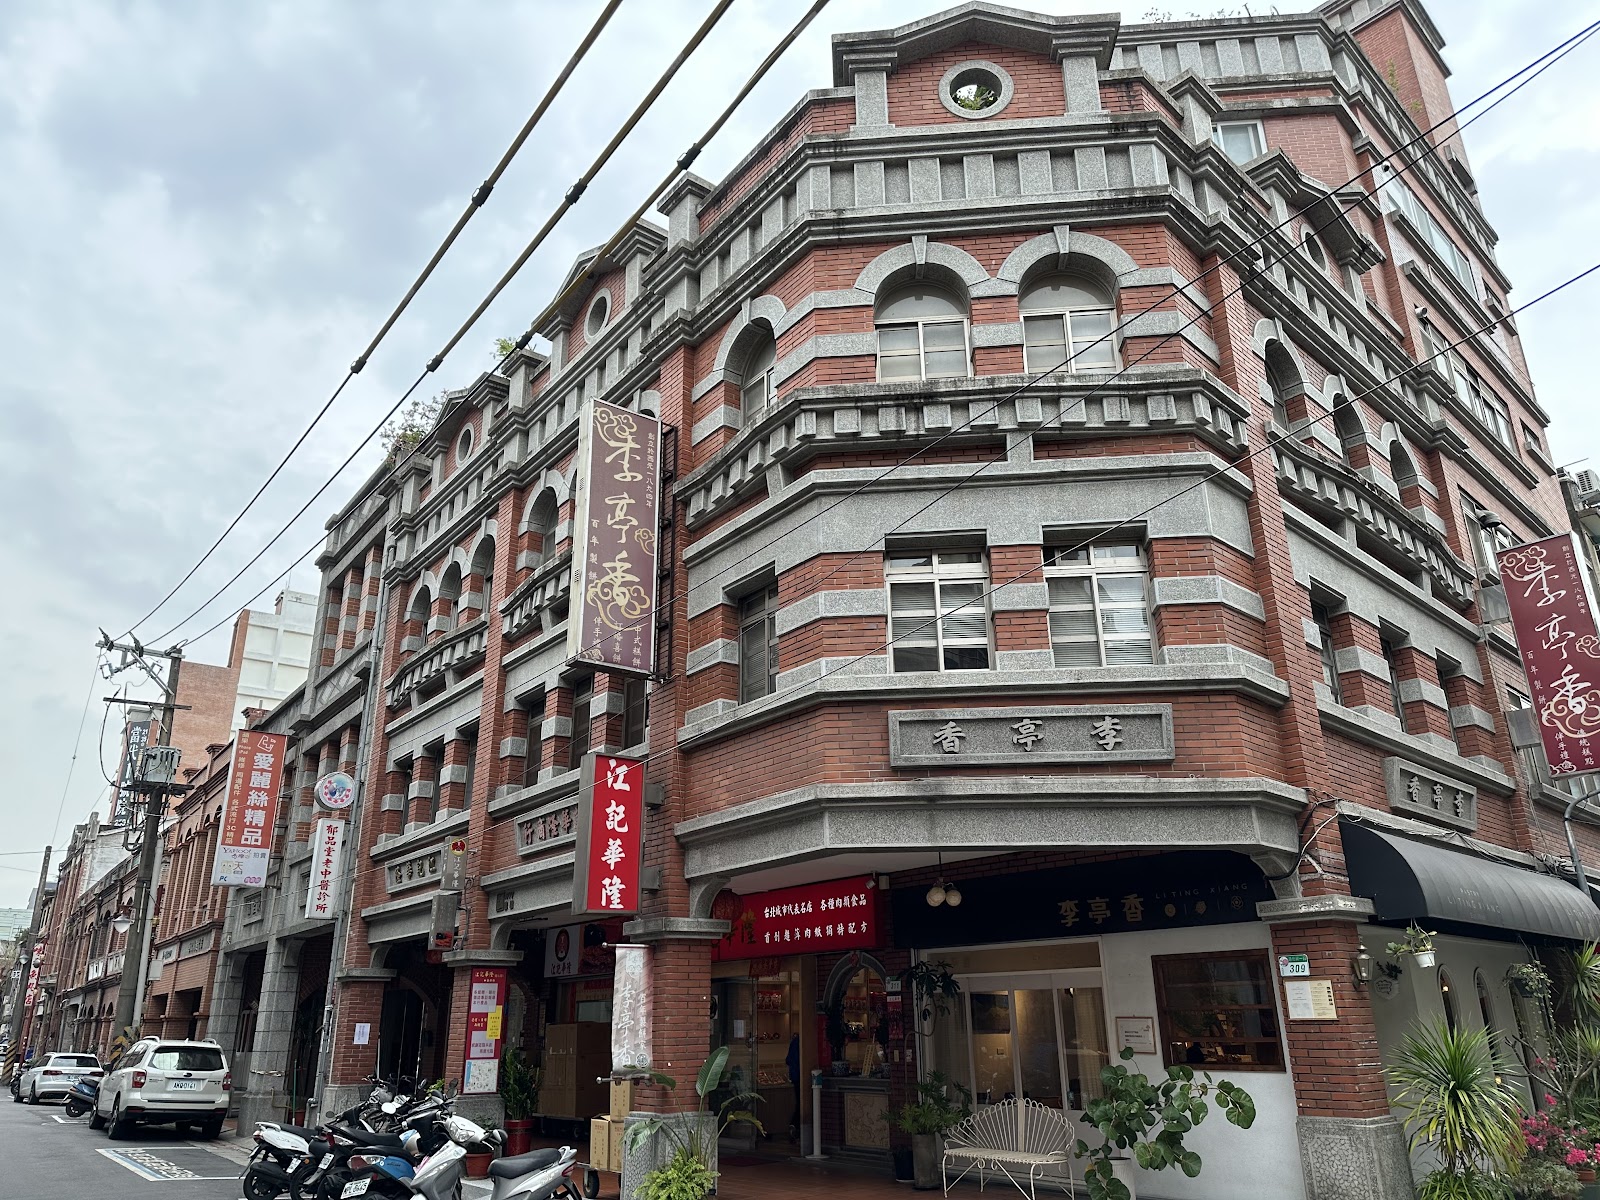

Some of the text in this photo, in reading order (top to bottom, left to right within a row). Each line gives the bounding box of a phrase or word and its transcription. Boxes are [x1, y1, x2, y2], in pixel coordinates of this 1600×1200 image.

[602, 435, 643, 606] 李亭香
[1524, 561, 1591, 715] 李亭香
[933, 716, 1124, 753] 李亭香
[241, 753, 275, 846] 愛麗絲精品
[601, 758, 631, 909] 江記華隆
[1407, 776, 1464, 817] 李亭香
[316, 824, 338, 914] 郁品堂老中醫診所
[1057, 893, 1144, 928] 李亭香
[1170, 888, 1200, 897] TING
[1209, 882, 1249, 894] XIANG
[1289, 963, 1306, 974] 309
[618, 982, 635, 1065] 李亭香
